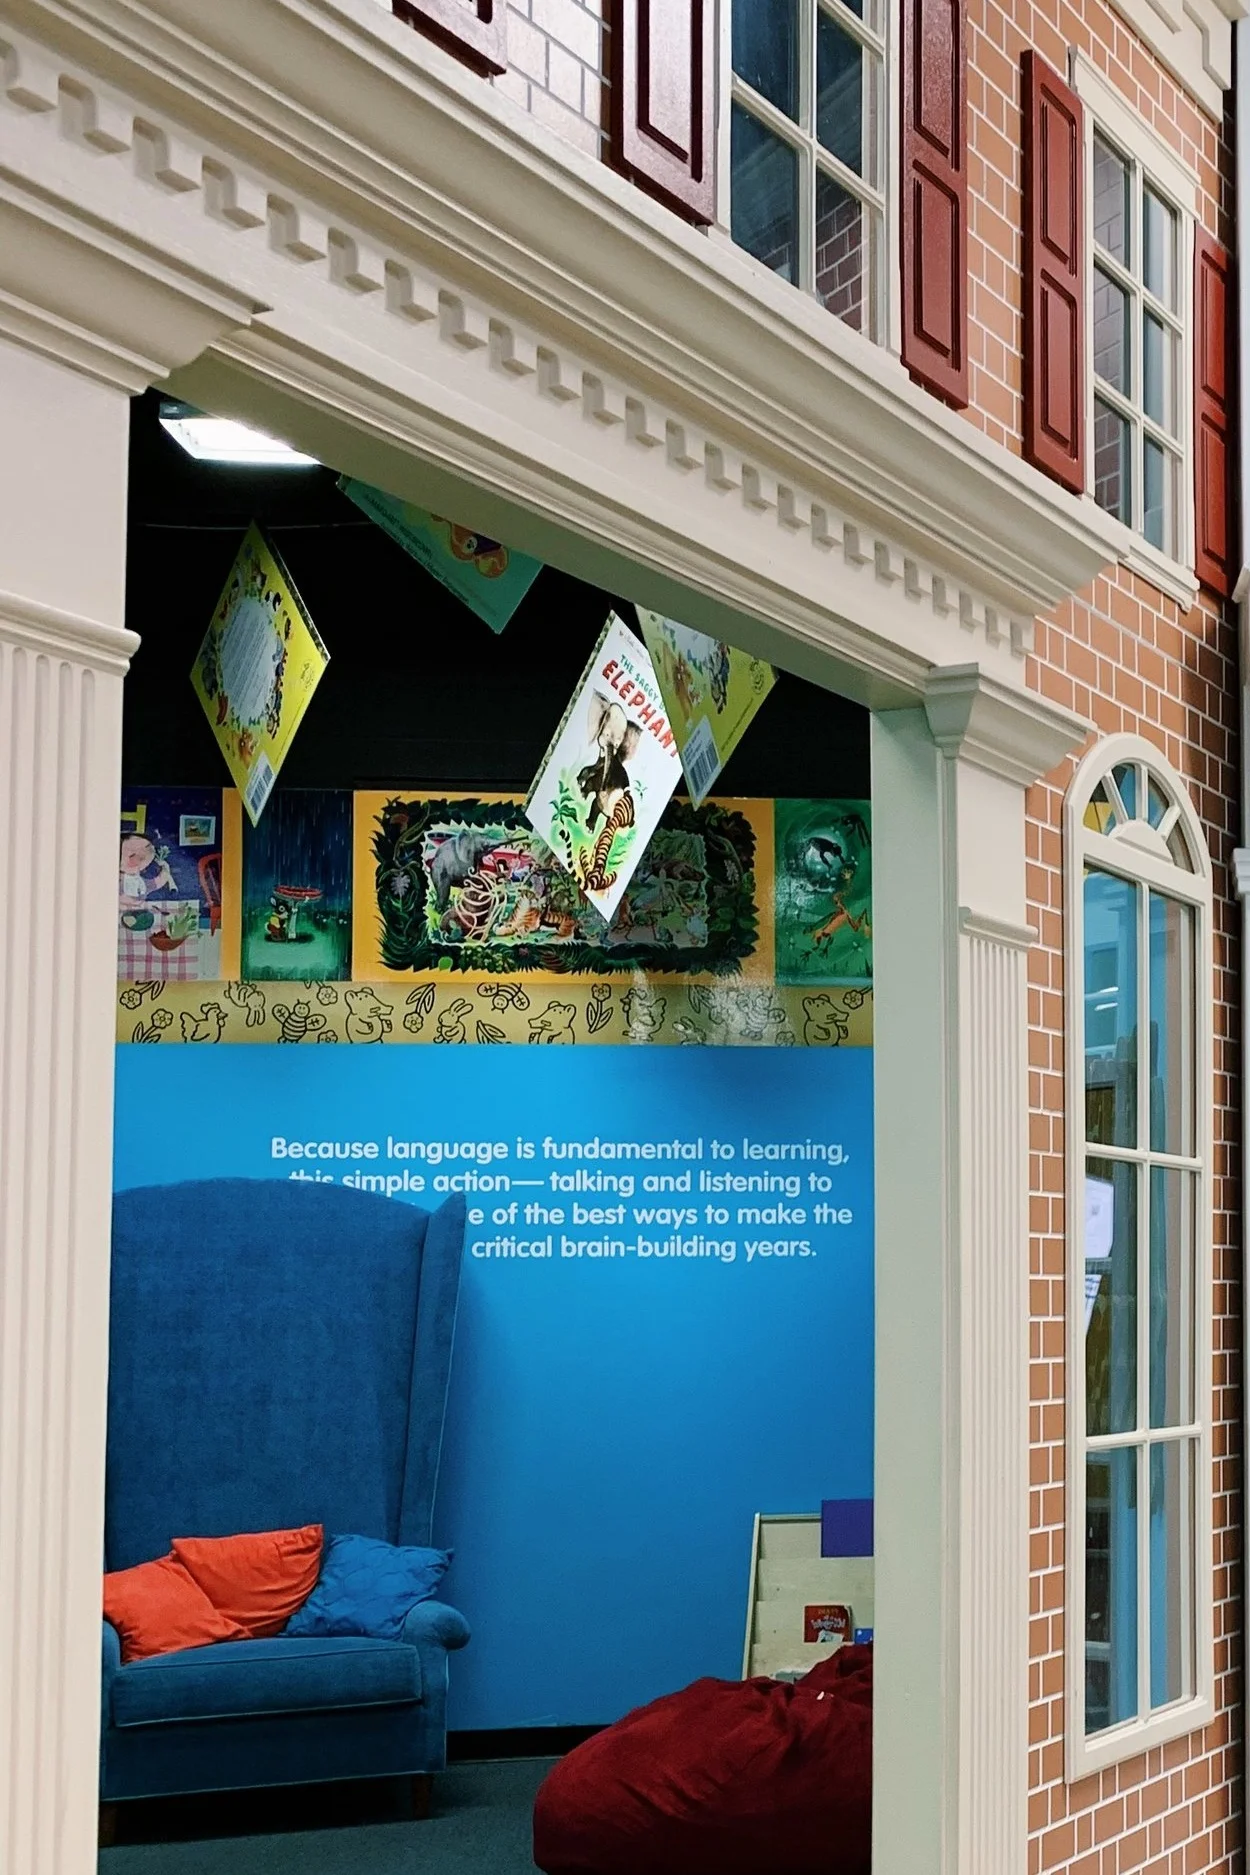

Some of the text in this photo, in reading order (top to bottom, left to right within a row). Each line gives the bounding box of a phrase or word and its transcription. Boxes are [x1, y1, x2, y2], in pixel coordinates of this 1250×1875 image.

[620, 654, 634, 674] THE
[635, 672, 659, 702] SAGGY
[272, 1137, 850, 1164] Because language is fundamental to learning,
[343, 1170, 424, 1198] simple
[550, 1170, 634, 1197] talking
[643, 1171, 690, 1191] and
[700, 1171, 800, 1197] listening
[808, 1173, 832, 1192] to
[493, 1203, 517, 1225] of
[524, 1203, 564, 1225] the
[573, 1203, 626, 1225] best
[633, 1208, 697, 1230] ways
[705, 1205, 729, 1225] to
[738, 1203, 806, 1225] make
[814, 1203, 852, 1225] the
[472, 1236, 817, 1262] critical brain-building years.
